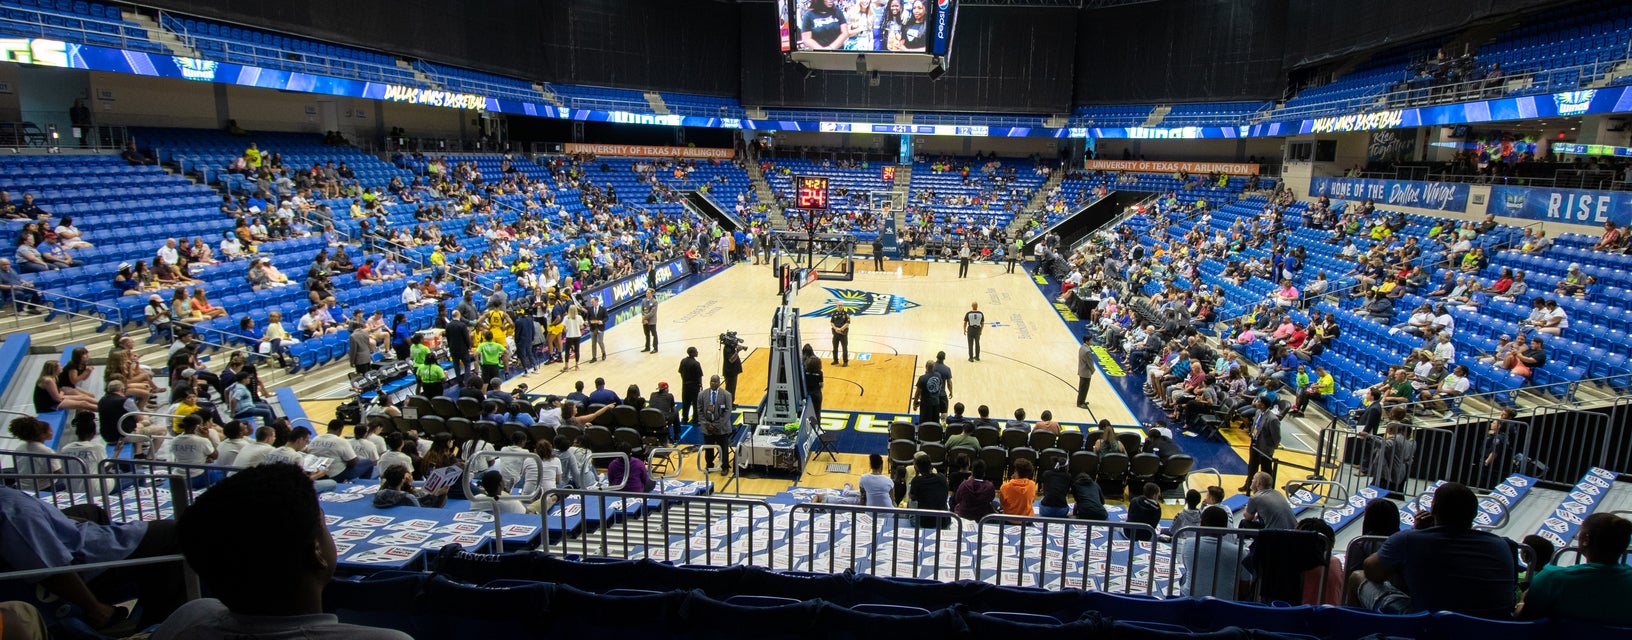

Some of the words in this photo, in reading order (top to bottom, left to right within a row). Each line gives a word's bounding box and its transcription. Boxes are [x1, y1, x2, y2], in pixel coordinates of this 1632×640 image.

[937, 10, 945, 39] pepsi
[384, 84, 419, 104] DALLAS
[419, 88, 444, 107] WINGS
[443, 91, 487, 110] BASKETBALL
[1311, 117, 1336, 134] DALLAS
[1333, 115, 1356, 132] WINGS
[1353, 109, 1403, 131] BASKETBALL
[575, 144, 626, 154] UNIVERSITY
[643, 146, 669, 156] TEXAS
[683, 148, 728, 158] ARLINGTON
[883, 171, 894, 180] 24
[1093, 160, 1138, 170] UNIVERSITY
[1139, 162, 1150, 170] OF
[1152, 161, 1179, 172] TEXAS
[1182, 163, 1192, 172] AT
[1195, 162, 1249, 174] ARLINGTON
[805, 179, 827, 189] 4:21
[801, 189, 823, 206] 24
[1330, 181, 1351, 196] HOME
[1354, 183, 1364, 198] OF
[1367, 184, 1384, 200] THE
[1389, 183, 1421, 204] Dallas
[1423, 182, 1457, 211] Wings
[1547, 192, 1611, 223] RISE
